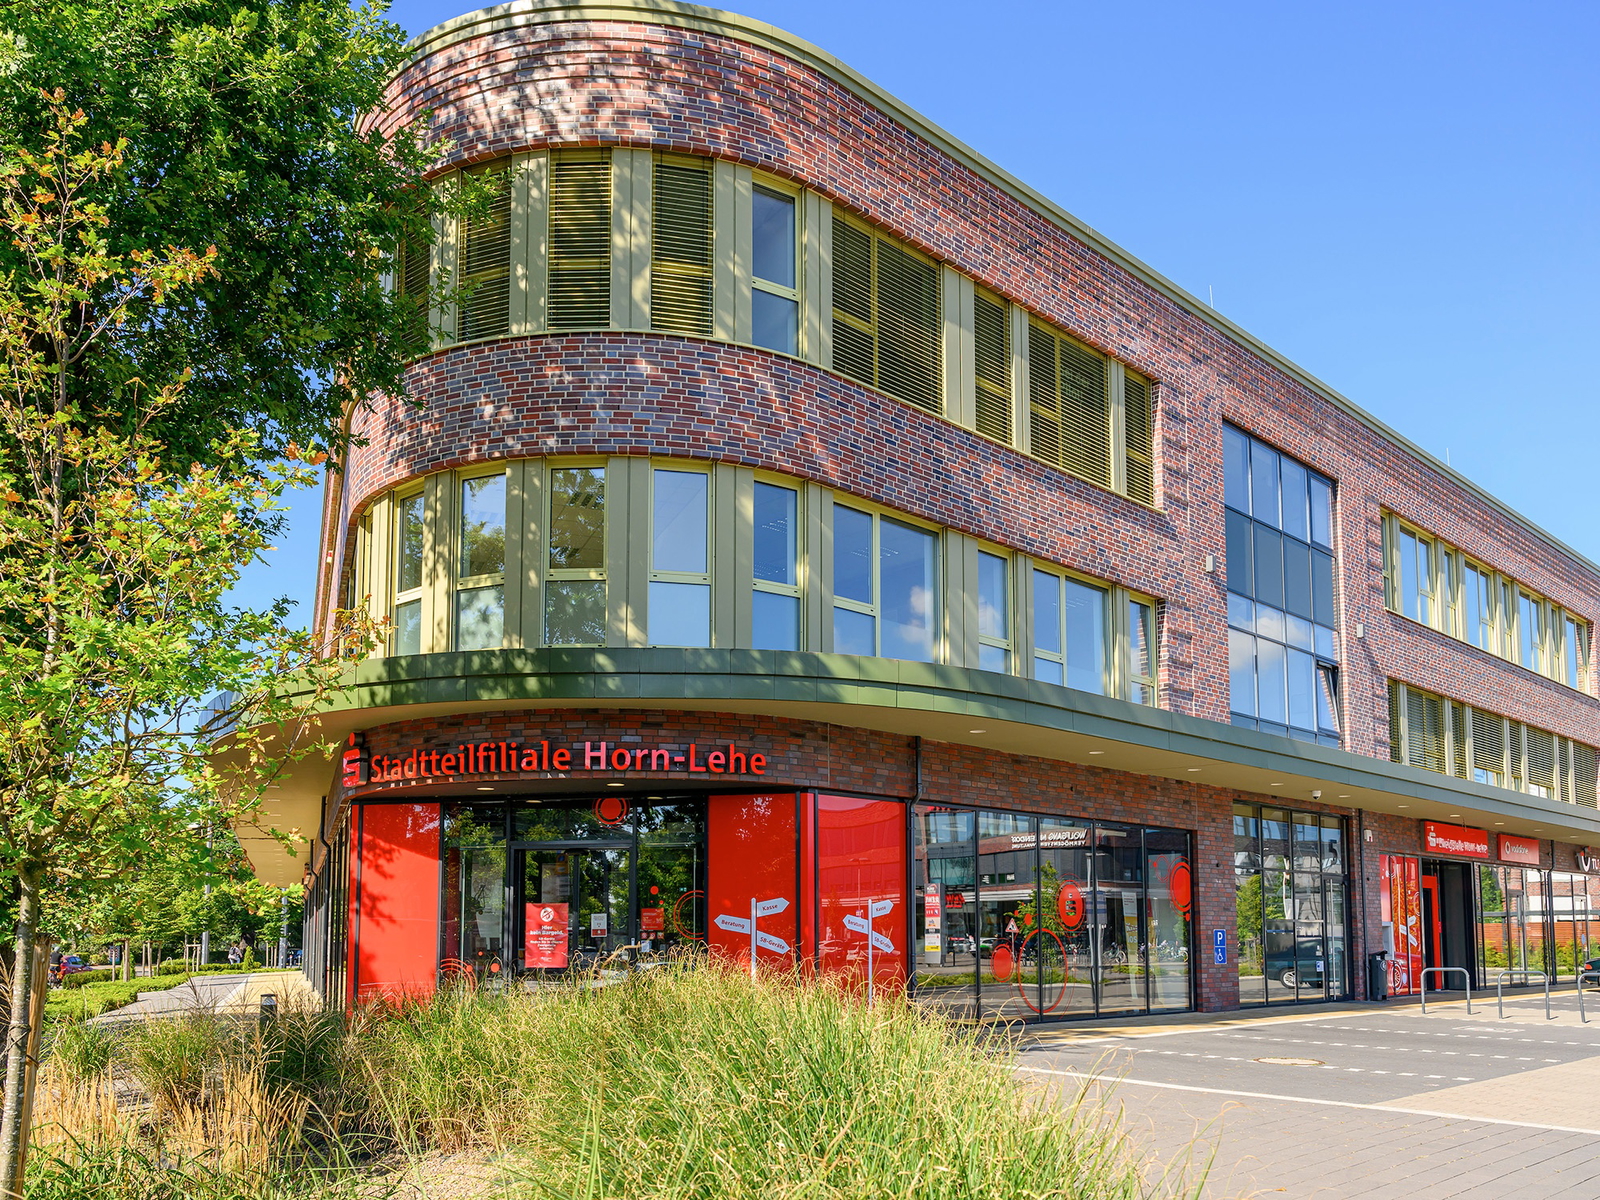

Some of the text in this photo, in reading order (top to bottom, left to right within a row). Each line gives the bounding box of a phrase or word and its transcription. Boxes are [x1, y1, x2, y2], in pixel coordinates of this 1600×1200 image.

[370, 740, 767, 783] Stadtteilfiliale Horn-Lehe
[1328, 839, 1338, 866] 5
[1510, 843, 1529, 855] vodafone
[721, 919, 745, 929] Beratung
[847, 919, 865, 929] Beratung
[760, 936, 785, 950] SB-Geräte
[1217, 932, 1223, 945] P
